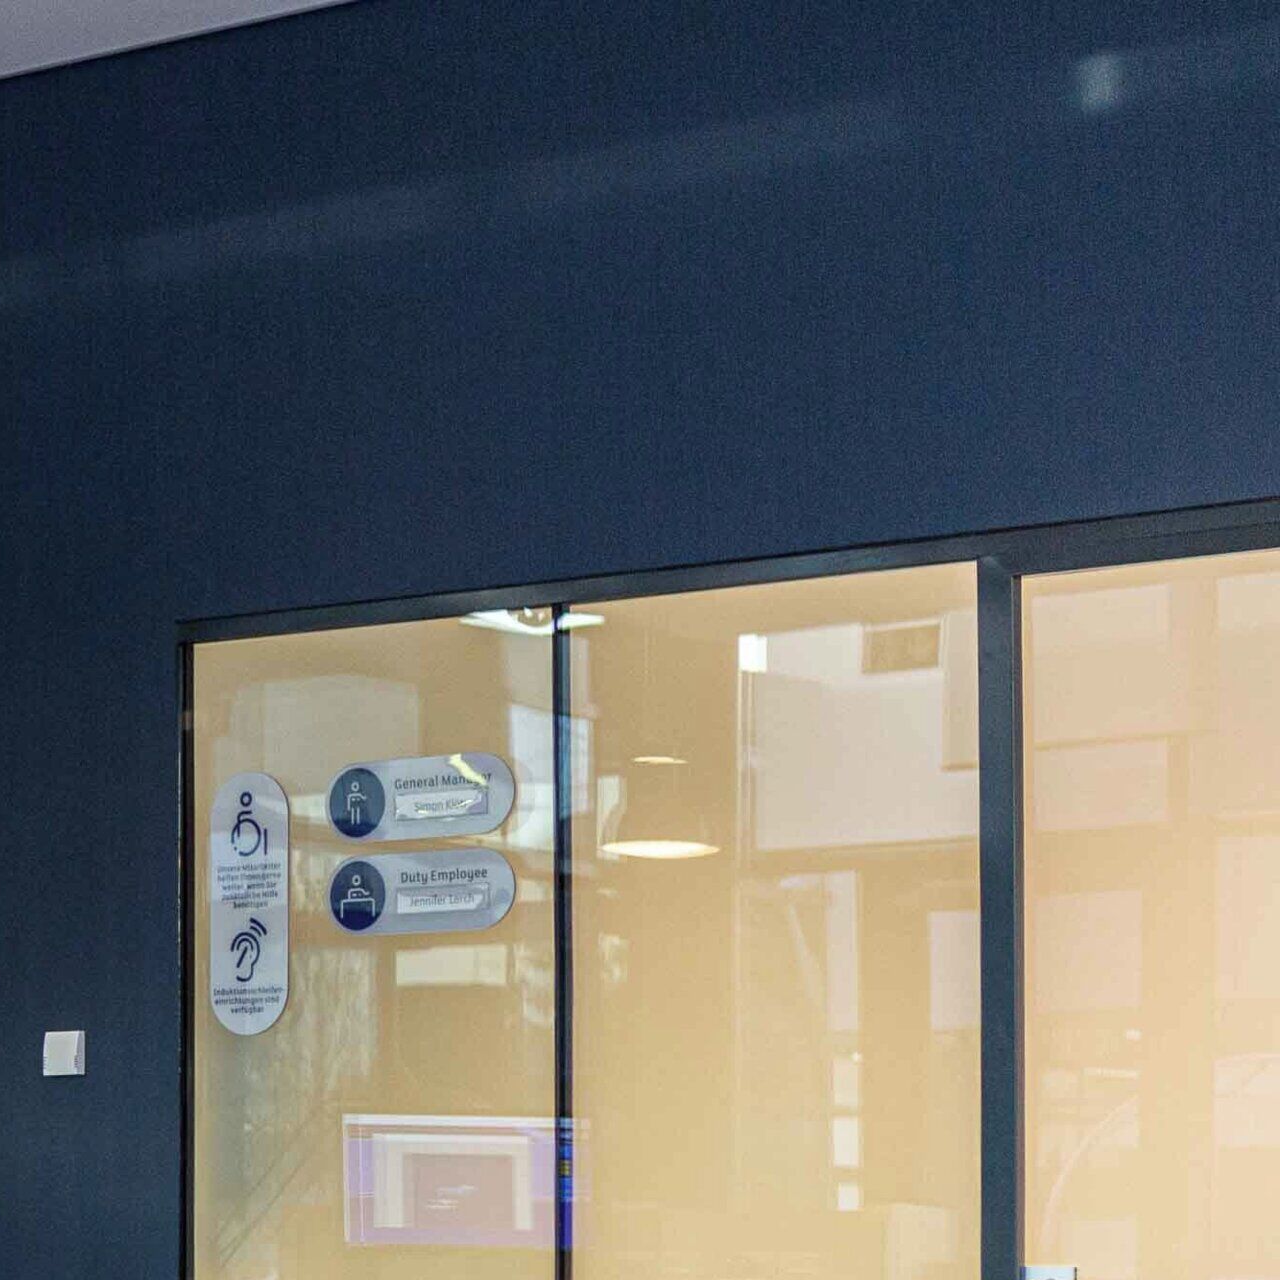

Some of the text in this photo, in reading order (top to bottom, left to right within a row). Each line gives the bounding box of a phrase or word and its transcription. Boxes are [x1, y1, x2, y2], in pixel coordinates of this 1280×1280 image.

[394, 775, 439, 790] General
[400, 867, 488, 885] Duty Employee
[410, 894, 446, 907] Jennifer
